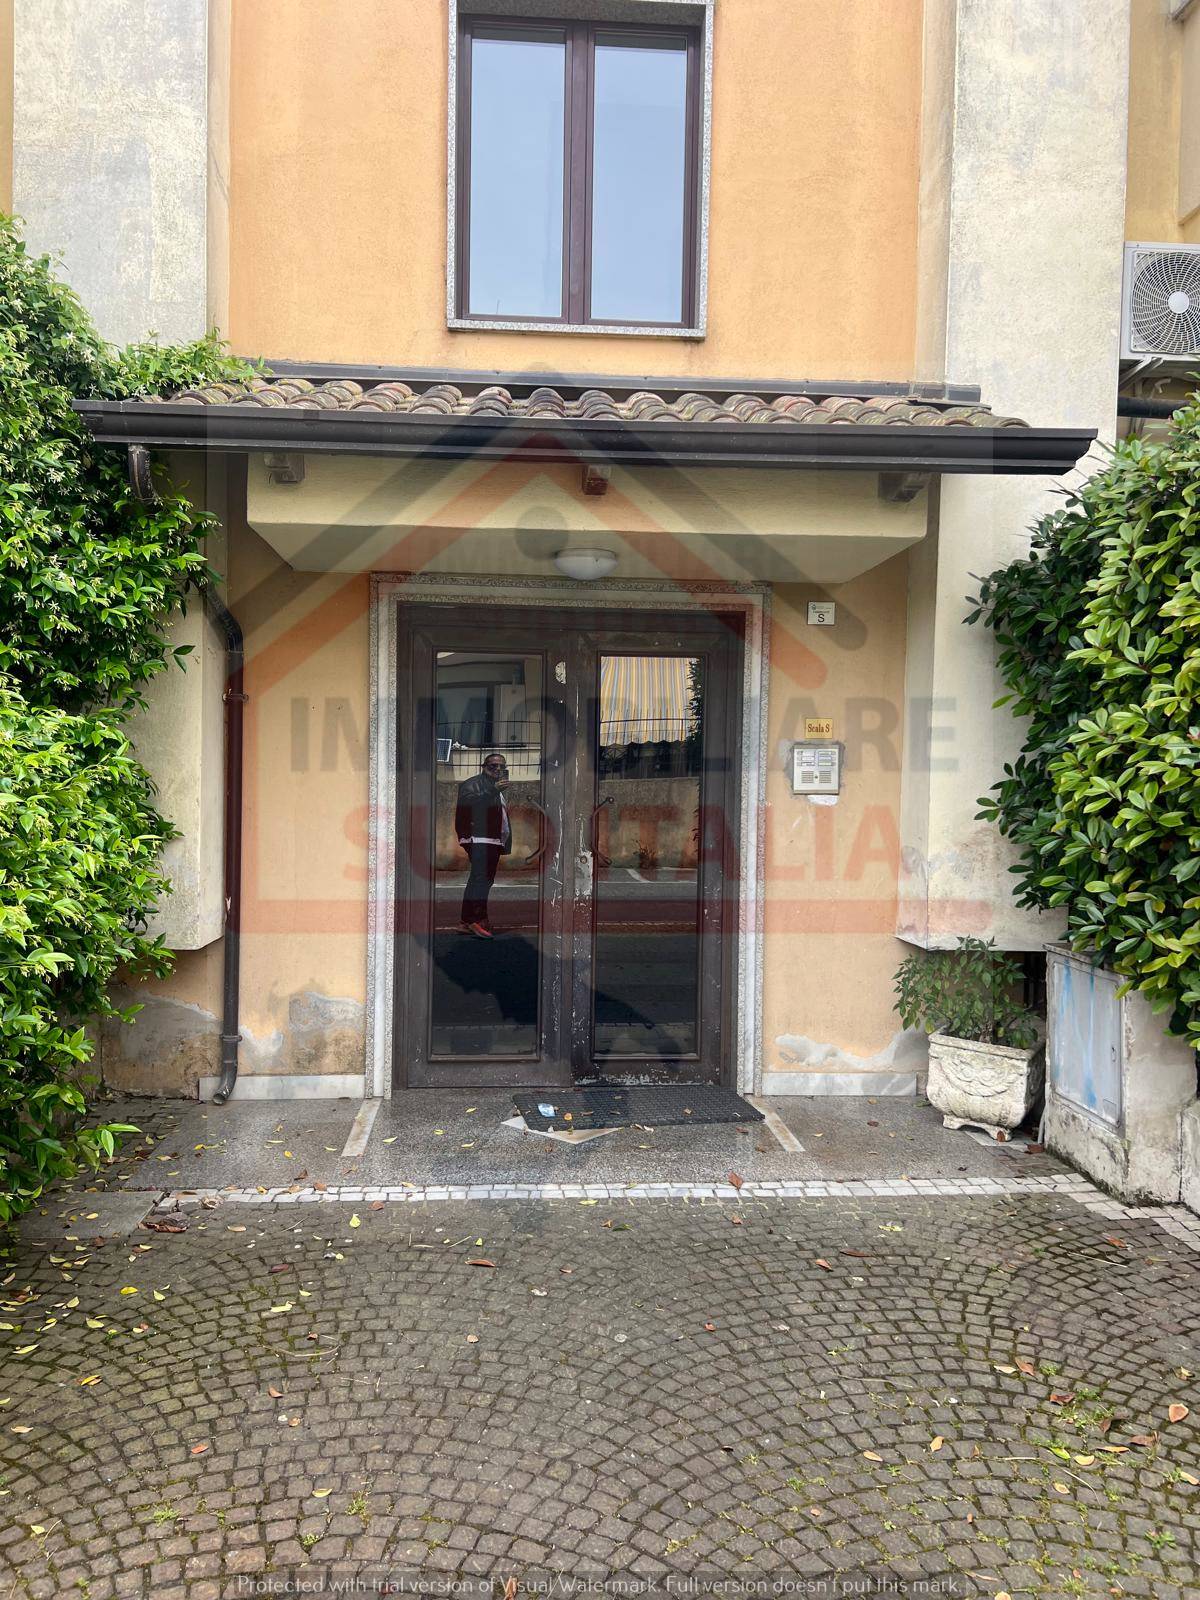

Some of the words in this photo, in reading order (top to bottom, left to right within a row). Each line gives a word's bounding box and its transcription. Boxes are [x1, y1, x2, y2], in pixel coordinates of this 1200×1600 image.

[817, 613, 825, 623] S
[807, 723, 824, 733] Scala
[825, 723, 830, 733] S
